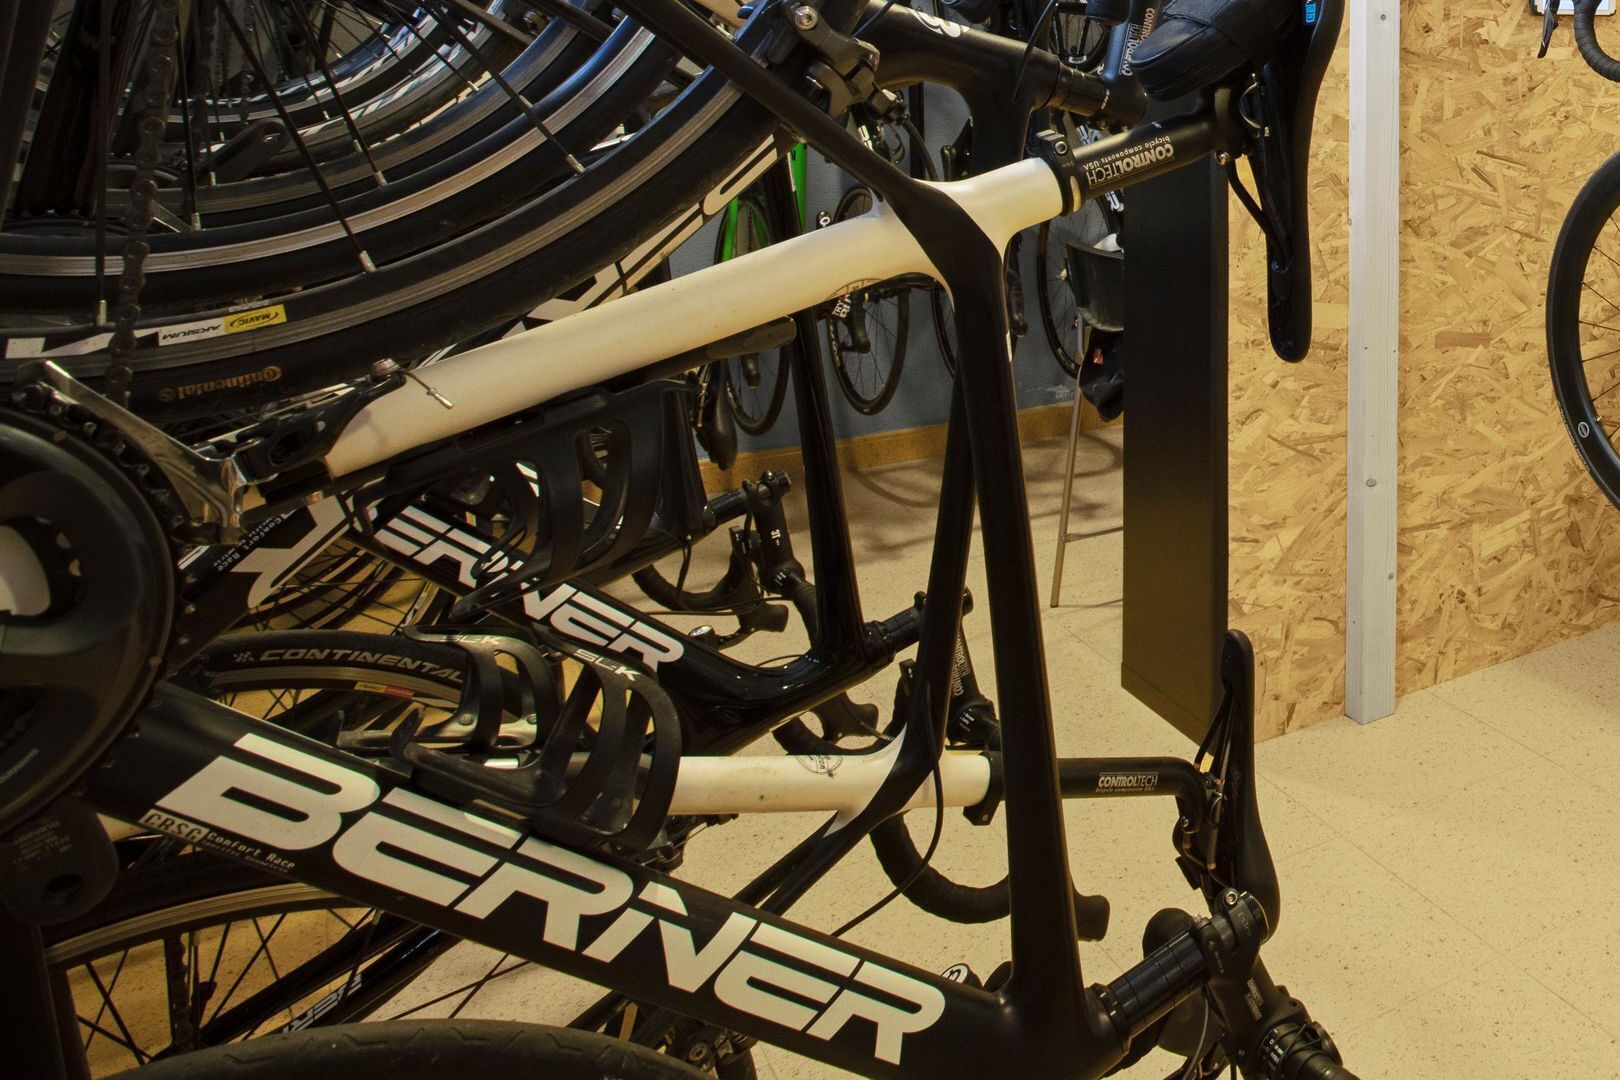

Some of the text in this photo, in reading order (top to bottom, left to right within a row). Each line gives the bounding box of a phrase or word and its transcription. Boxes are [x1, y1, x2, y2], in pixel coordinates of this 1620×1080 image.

[1083, 161, 1100, 171] USA
[1086, 143, 1174, 186] CONTROLTECH
[238, 312, 272, 326] MAVIC
[258, 648, 464, 685] CONTINENTAL
[573, 648, 641, 682] SLK
[1098, 775, 1159, 788] CONTROLTECH
[207, 831, 262, 857] Confort
[265, 852, 296, 870] Race
[153, 732, 946, 1066] BERNER
